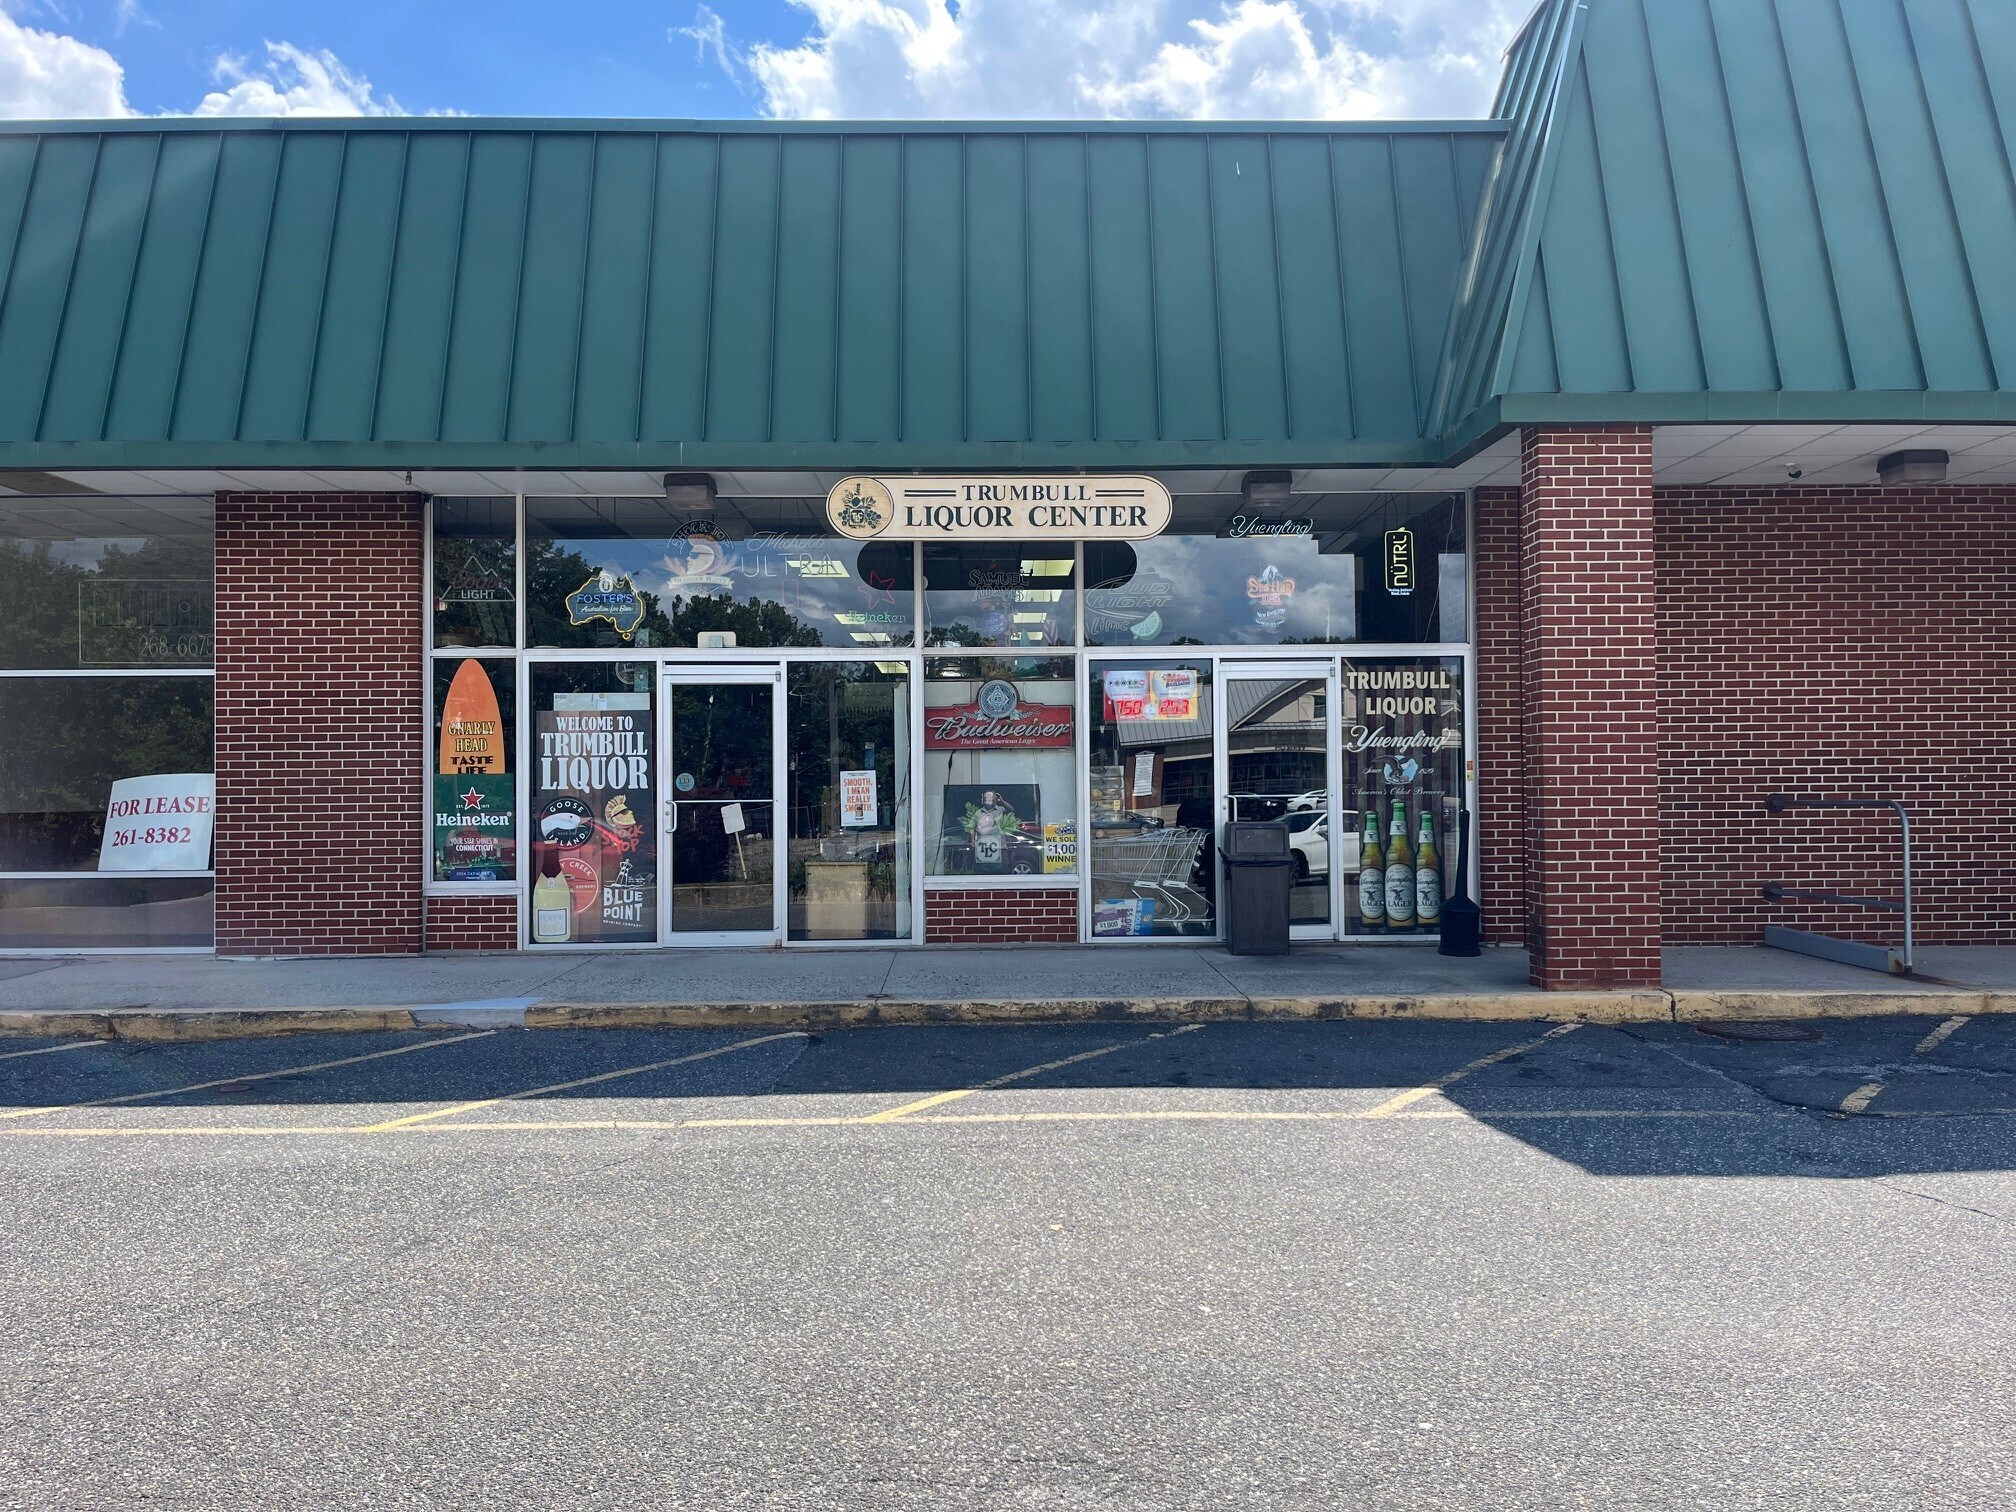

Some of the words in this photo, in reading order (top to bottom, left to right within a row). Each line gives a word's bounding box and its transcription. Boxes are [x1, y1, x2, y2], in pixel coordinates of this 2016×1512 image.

[961, 484, 1091, 501] TRUMBULL
[904, 505, 1014, 532] LIQUOR
[1028, 504, 1149, 527] CENTER
[1229, 515, 1314, 538] Yuengling
[741, 552, 839, 578] ULTRA
[969, 569, 1030, 587] SAMUEL
[461, 589, 496, 599] LIGHT
[972, 585, 1025, 603] ADAMS
[1108, 582, 1171, 595] BUD
[576, 594, 633, 604] FOSTER'S
[1091, 595, 1174, 609] LIGHT
[846, 610, 906, 623] Heineken
[1346, 671, 1450, 690] TRUMBULL
[1365, 696, 1437, 719] LIQUOR
[447, 721, 496, 736] GNARLY
[556, 716, 614, 731] WELCOME
[616, 715, 634, 731] TO
[926, 716, 1071, 741] Budweiser
[455, 738, 488, 752] HEAD
[540, 731, 648, 757] TRUMBULL
[1346, 725, 1451, 754] Yuengling
[450, 755, 494, 766] TASTE
[540, 756, 649, 794] LIQUOR
[851, 786, 870, 795] MEAN
[1352, 787, 1387, 795] America's
[1389, 786, 1411, 795] Oldest
[1413, 786, 1445, 797] Brewery
[109, 799, 141, 819] FOR
[143, 796, 211, 815] LEASE
[549, 800, 584, 813] GOOSE
[846, 795, 871, 804] REALLY
[435, 811, 510, 827] Heineken
[111, 826, 192, 847] 261-8382
[449, 837, 463, 846] YOUR
[463, 837, 475, 845] STAR
[493, 837, 499, 845] IN
[548, 833, 586, 847] ISLAND
[455, 844, 494, 852] CONNECTICUT
[978, 842, 998, 858] TLC
[1048, 843, 1077, 855] $1,00
[569, 860, 593, 877] CREEK
[603, 887, 643, 906] BLUE
[603, 903, 643, 922] POINT
[1137, 900, 1144, 911] WE
[1134, 913, 1143, 930] SOLD
